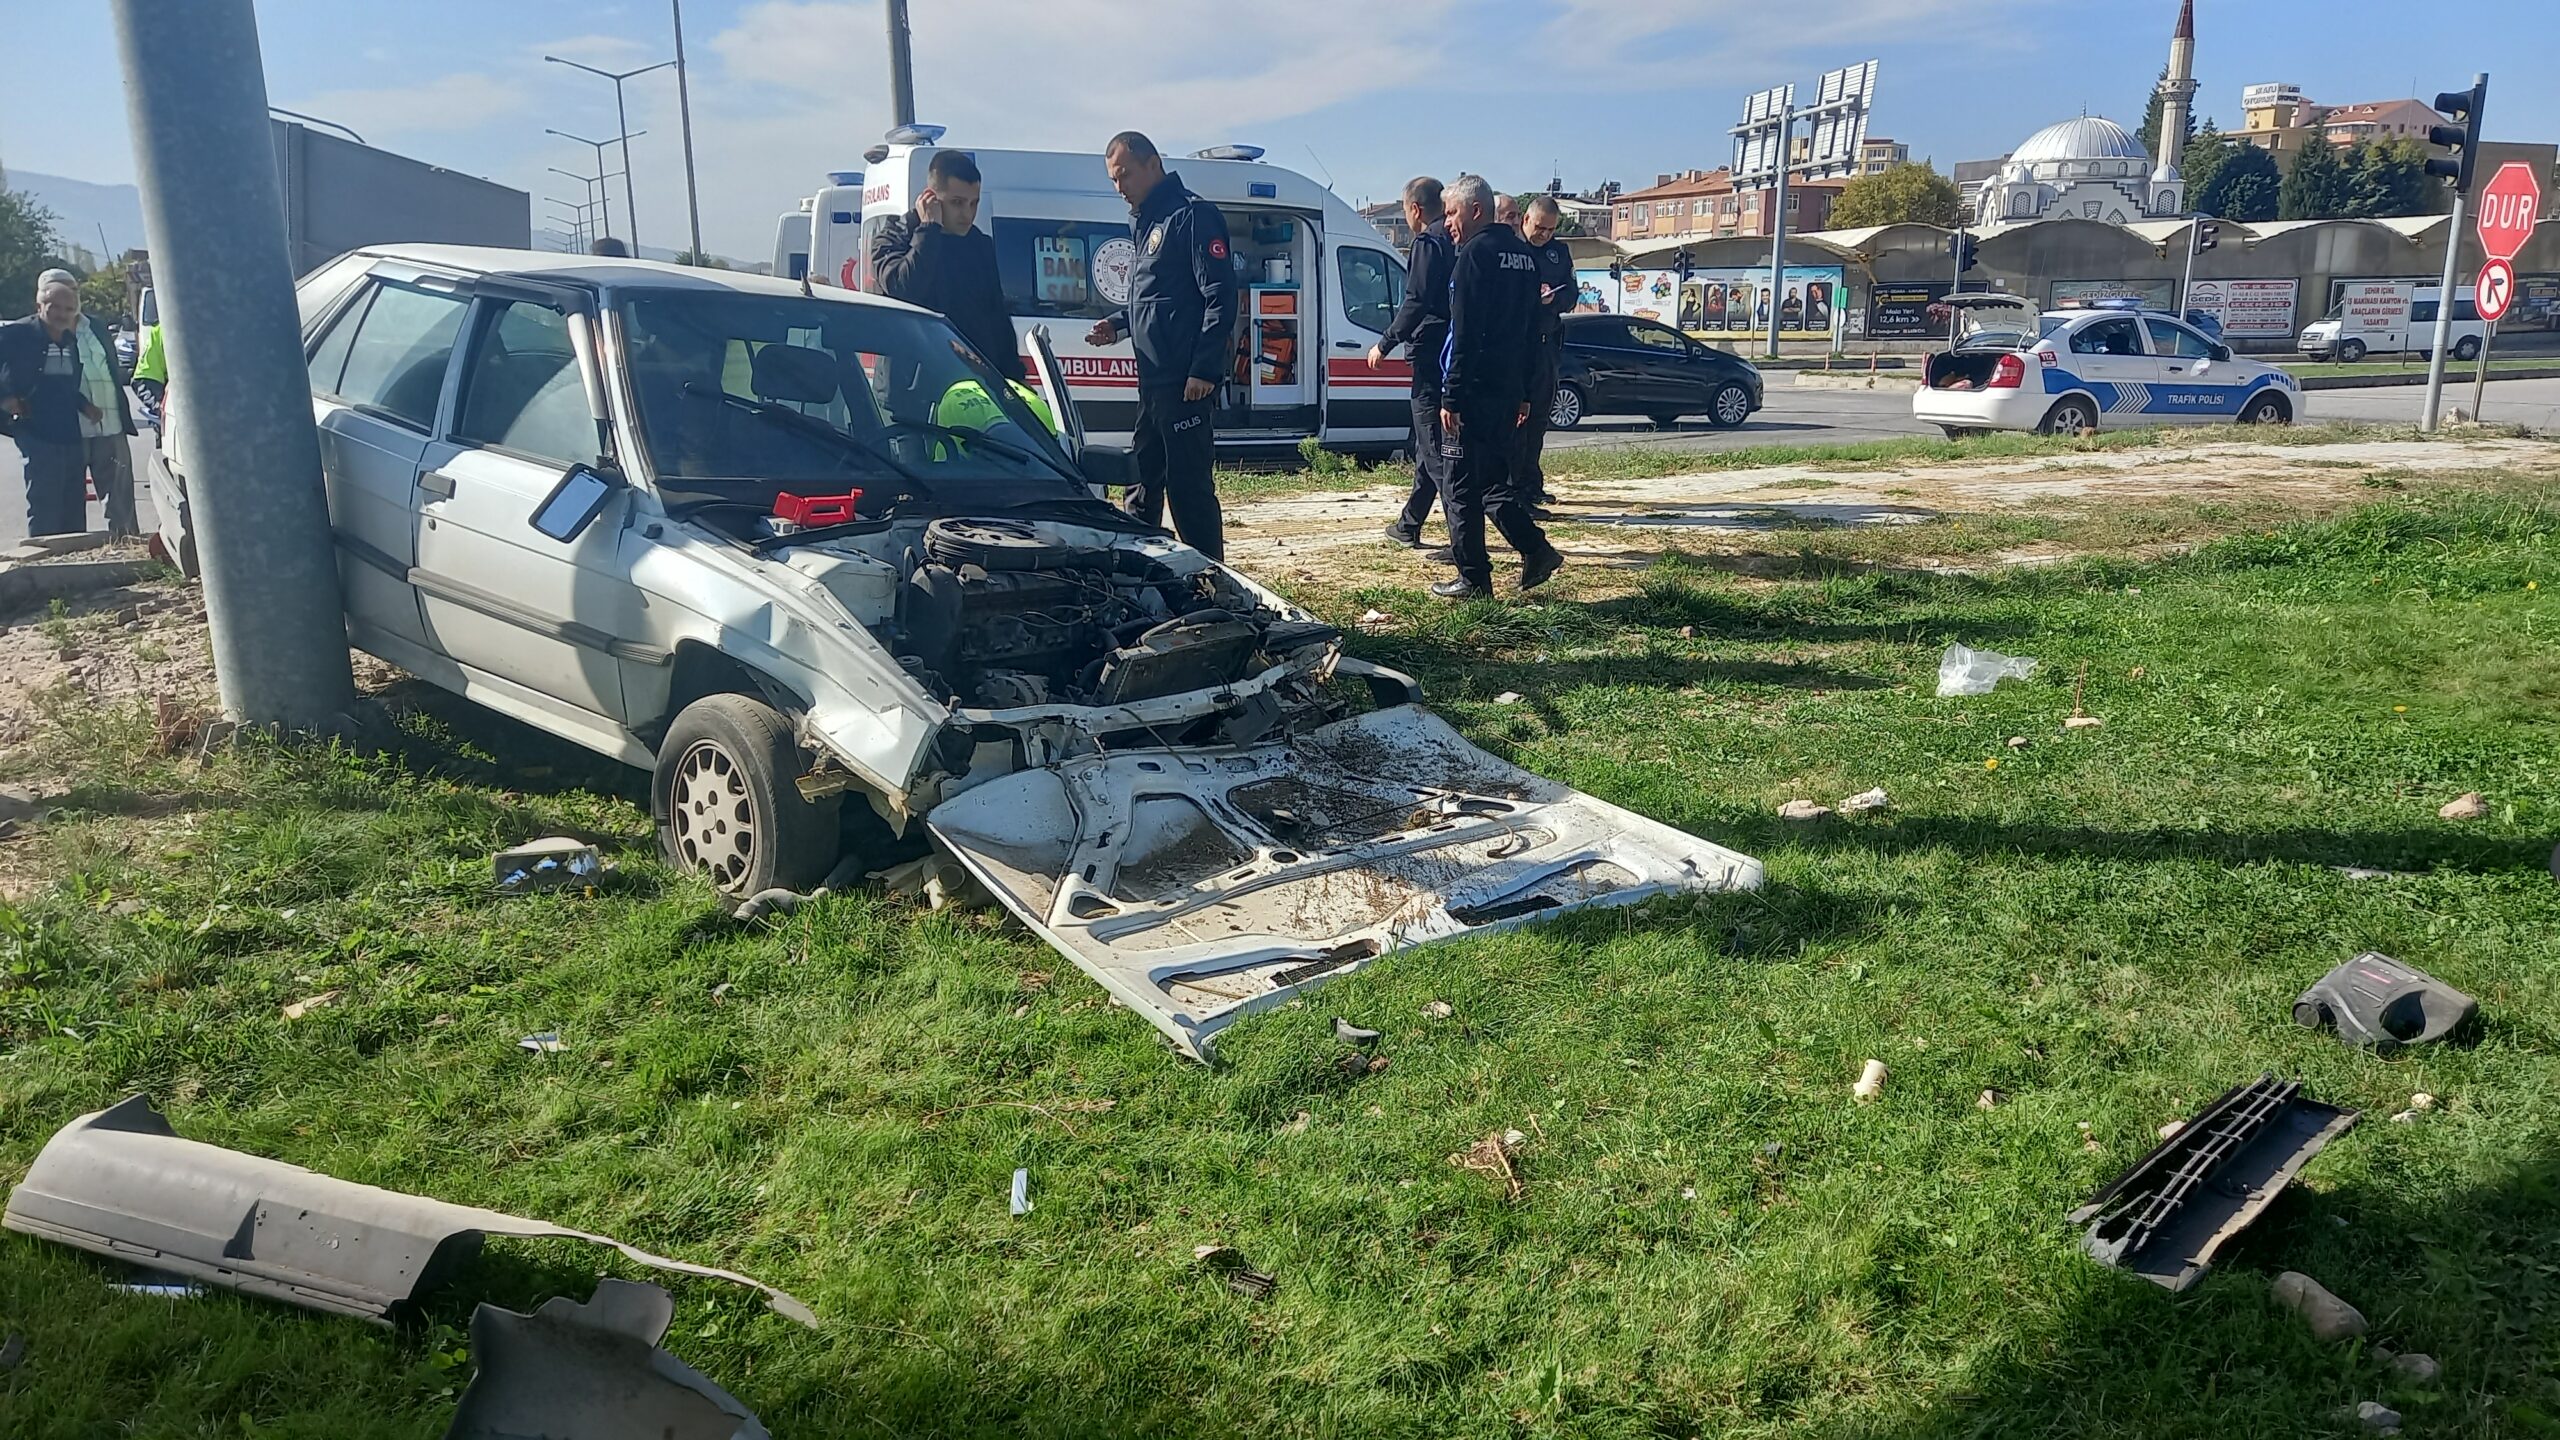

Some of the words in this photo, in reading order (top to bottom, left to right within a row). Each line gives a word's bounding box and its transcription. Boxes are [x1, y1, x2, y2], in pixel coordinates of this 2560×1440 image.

[2482, 193, 2533, 231] DUR
[1498, 252, 1536, 272] ZABITA
[1880, 316, 1894, 324] 12,6
[1058, 359, 1139, 376] MBULAN
[2168, 394, 2198, 404] TRAFİK
[2198, 394, 2226, 405] POLİSİ
